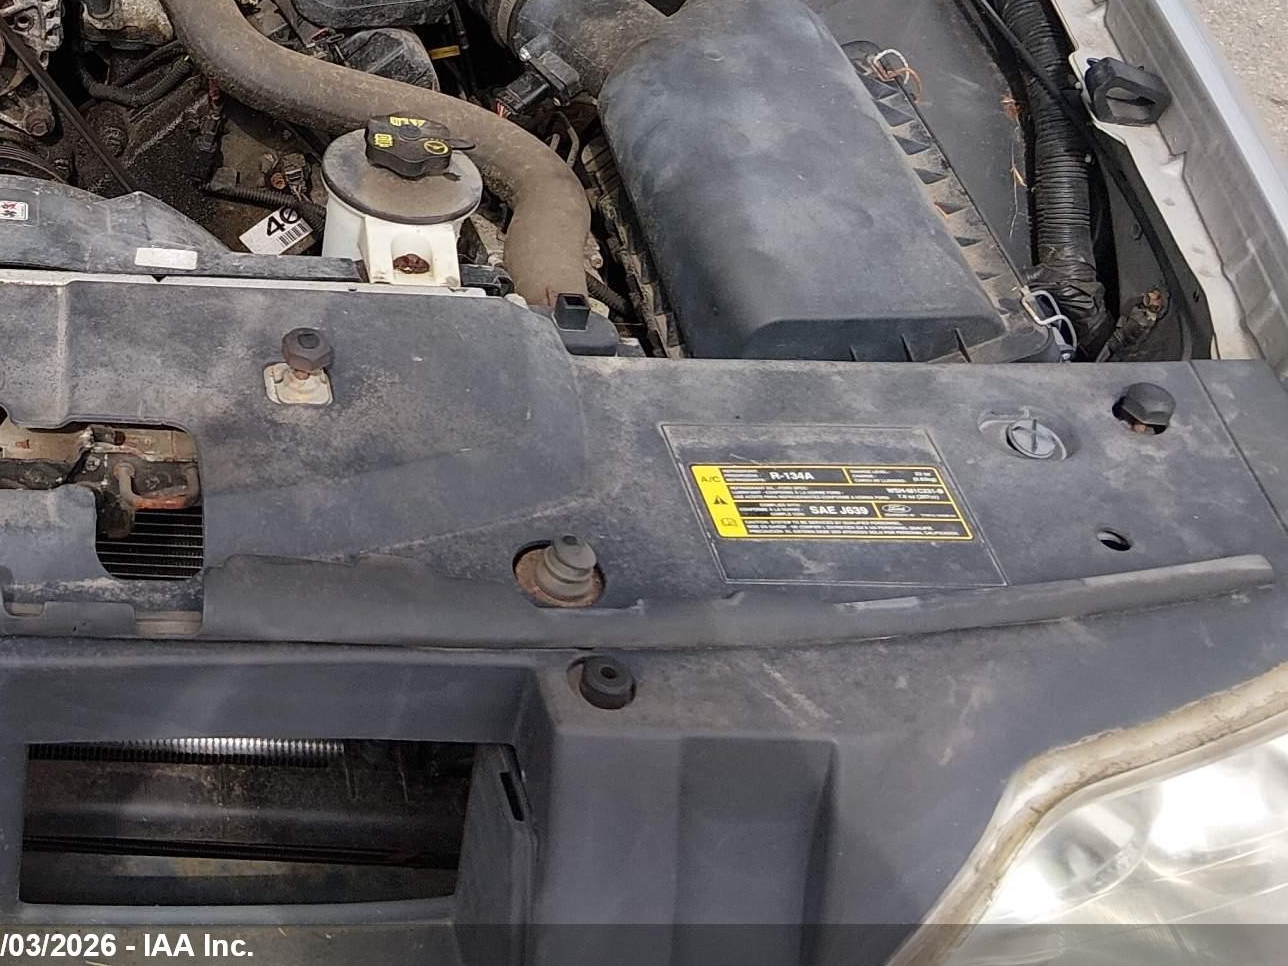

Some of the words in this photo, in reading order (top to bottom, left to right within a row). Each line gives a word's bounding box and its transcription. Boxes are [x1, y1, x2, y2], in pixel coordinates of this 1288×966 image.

[701, 475, 721, 483] A/C
[769, 471, 815, 480] R-134A
[809, 505, 838, 515] SAE
[839, 506, 869, 515] J639
